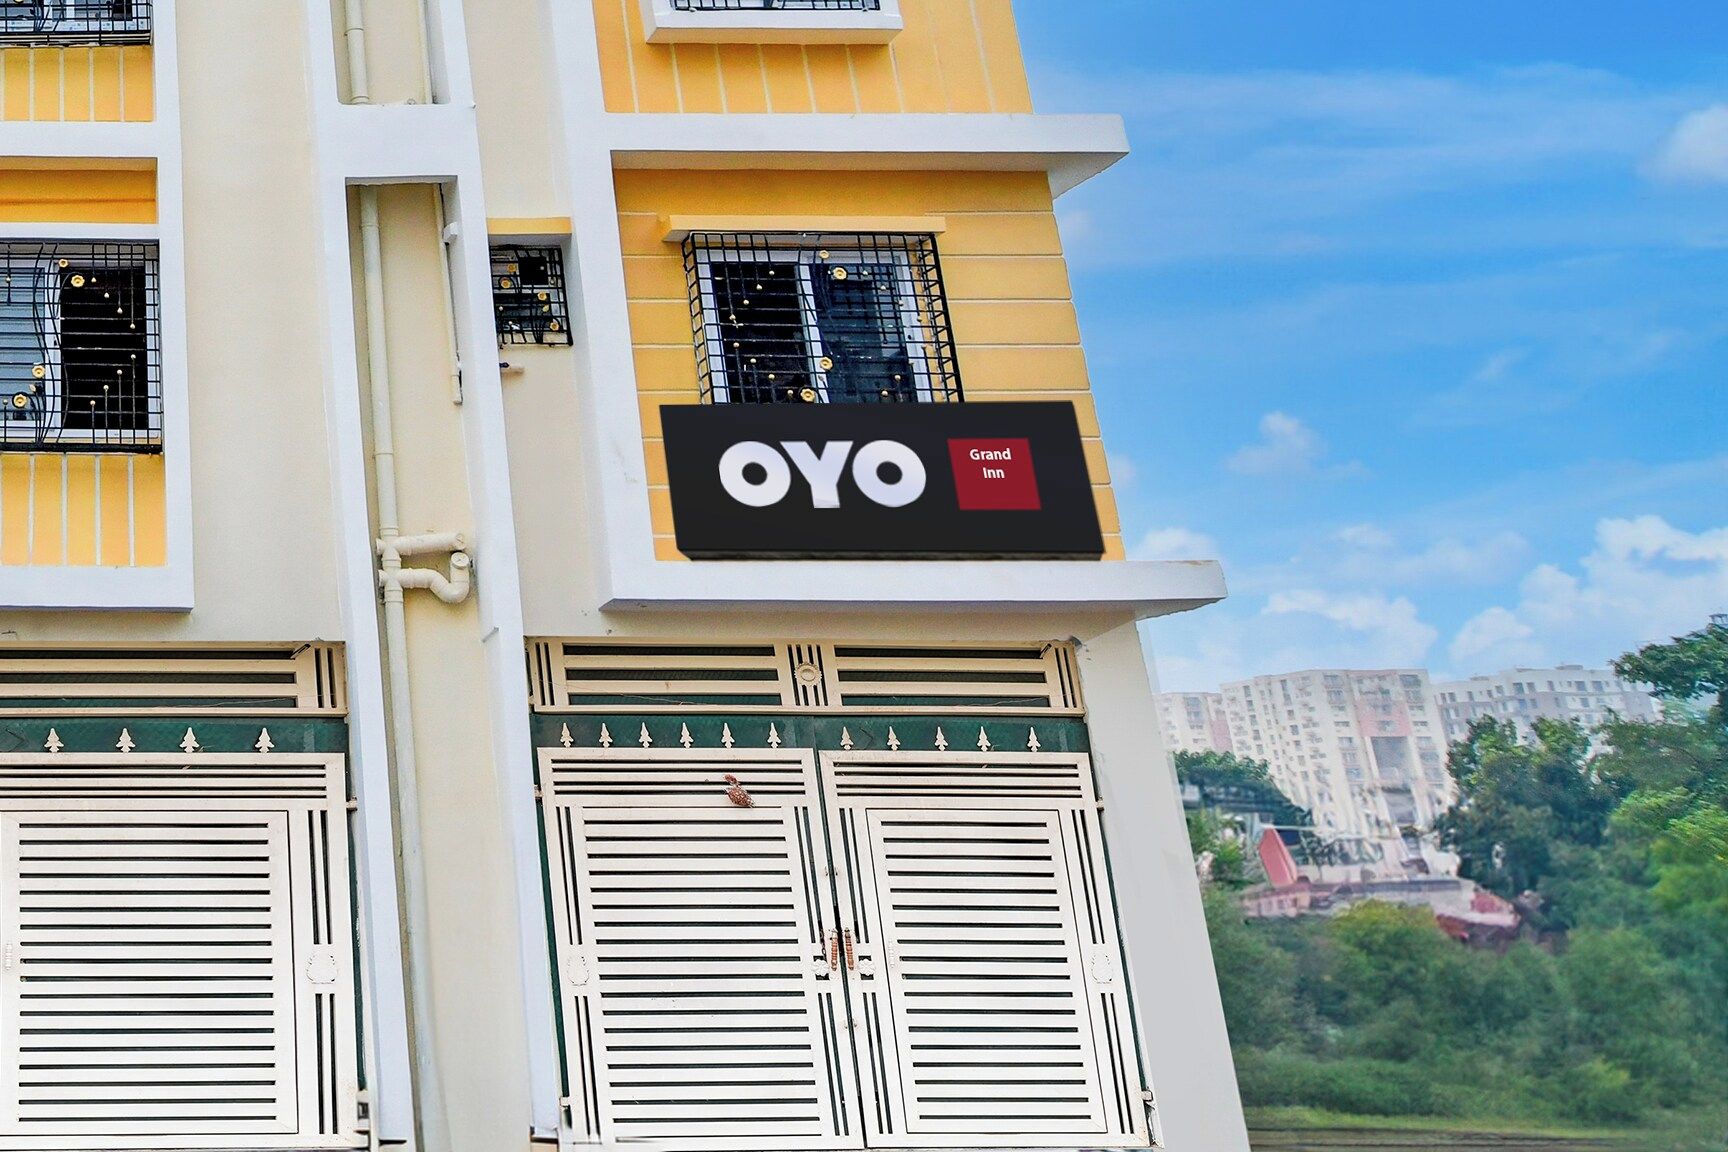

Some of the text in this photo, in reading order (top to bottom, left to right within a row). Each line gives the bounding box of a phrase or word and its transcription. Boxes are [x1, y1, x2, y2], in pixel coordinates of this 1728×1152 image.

[969, 447, 1012, 461] Grand
[719, 439, 927, 508] OYO
[983, 467, 1006, 479] Inn
